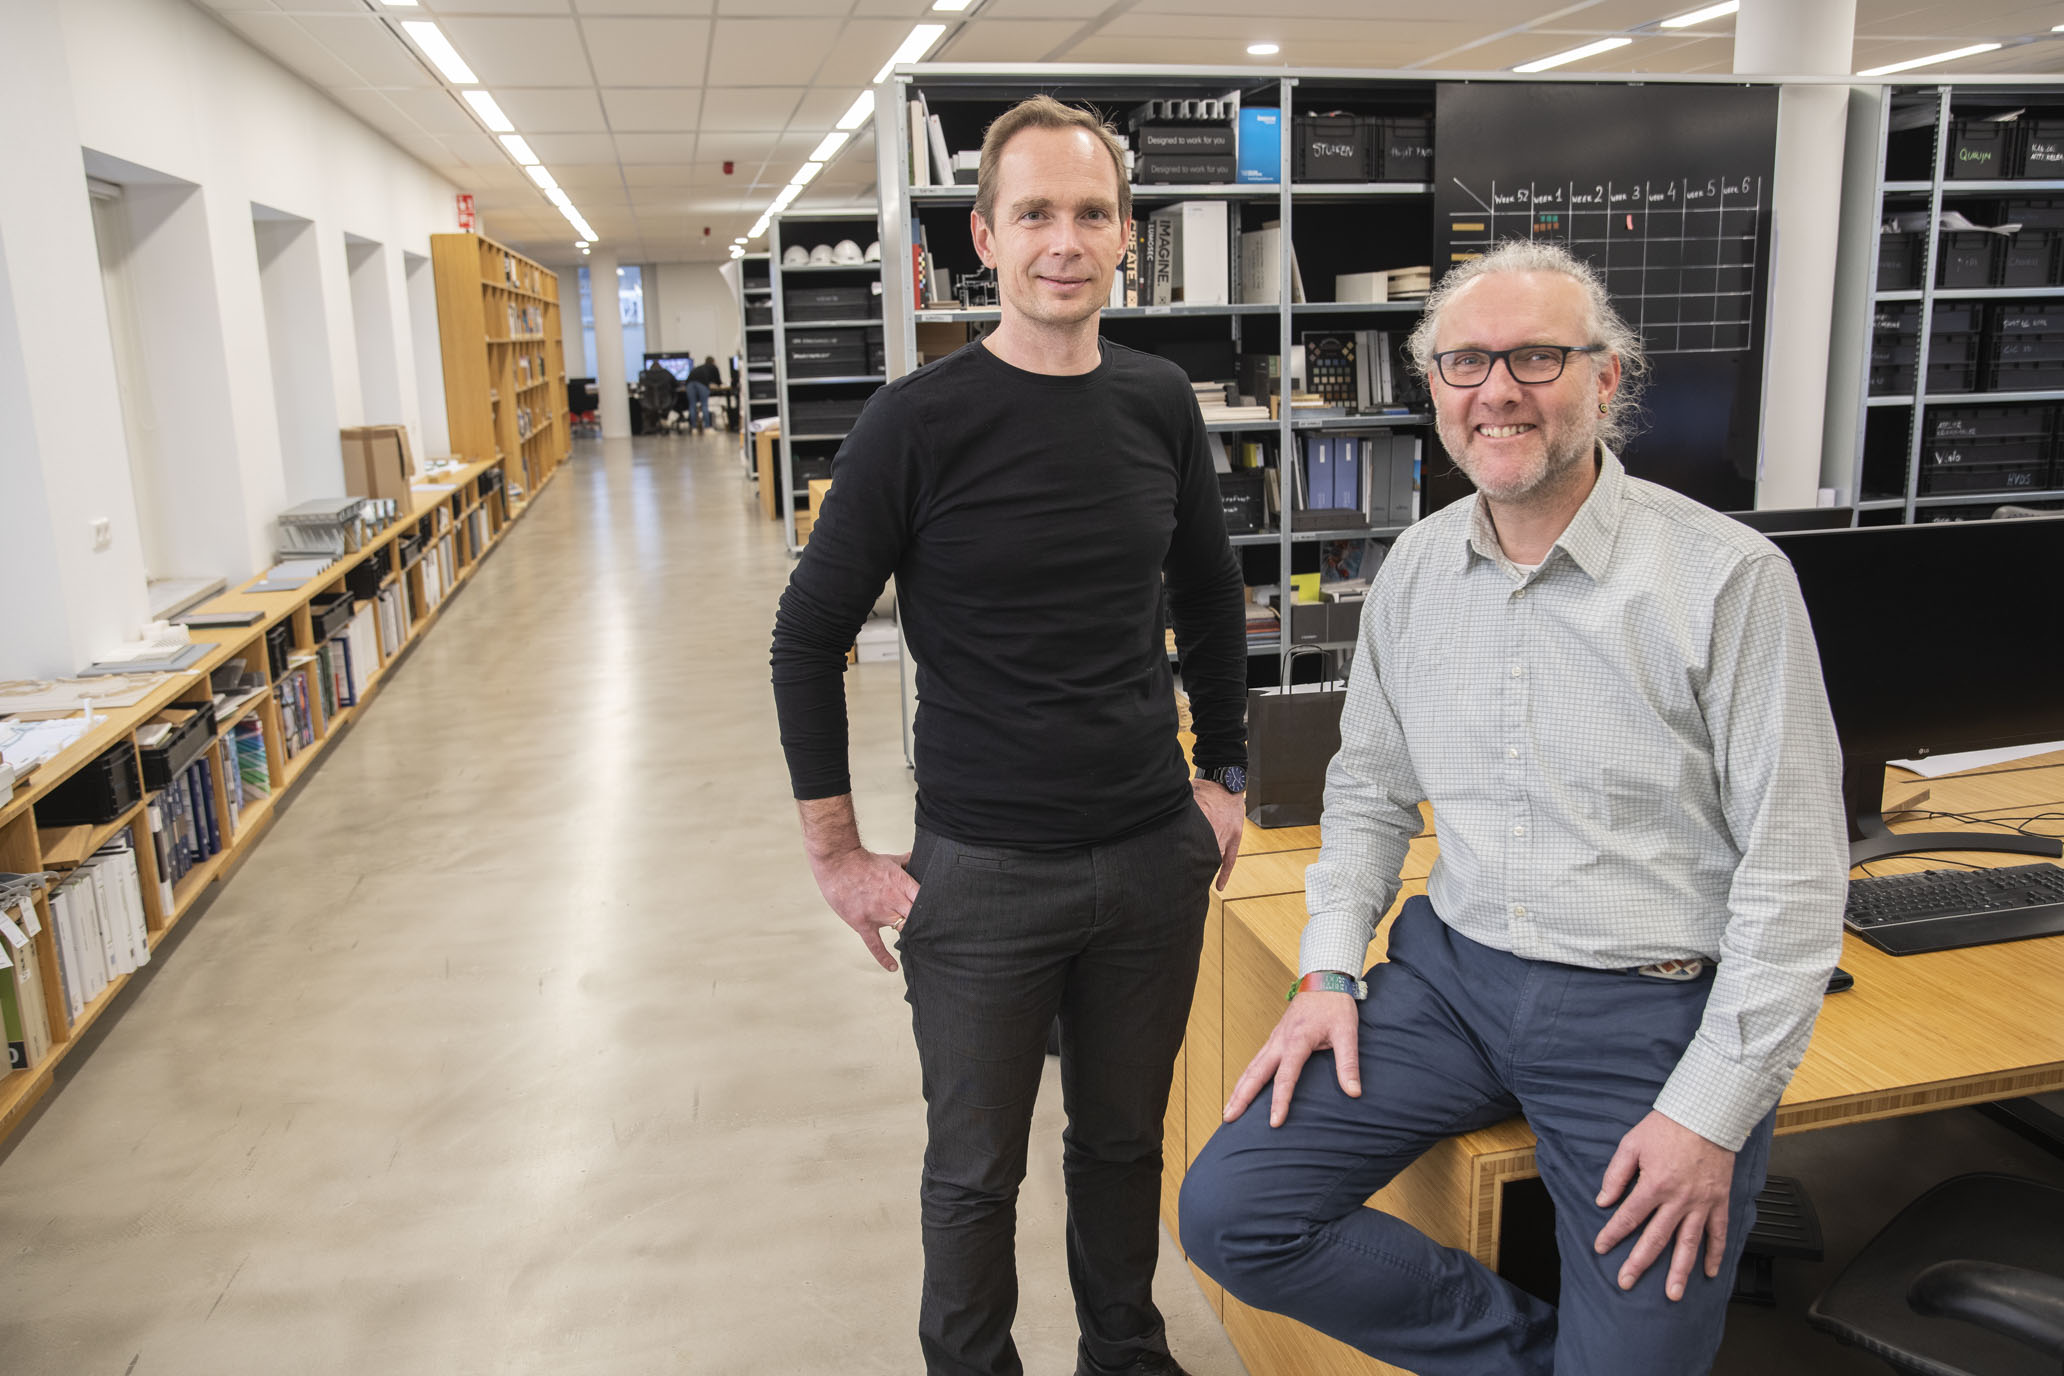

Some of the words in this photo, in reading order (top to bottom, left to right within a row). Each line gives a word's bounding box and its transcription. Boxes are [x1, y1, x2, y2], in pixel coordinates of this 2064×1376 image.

[1147, 135, 1178, 146] Designed
[1178, 136, 1186, 144] to
[1186, 136, 1202, 144] work
[1203, 135, 1212, 144] for
[1213, 137, 1226, 146] you
[1151, 165, 1181, 174] Designed
[1181, 165, 1189, 173] to
[1189, 165, 1205, 173] work
[1206, 165, 1215, 173] for
[1216, 166, 1229, 175] you
[1631, 185, 1640, 200] 3
[1667, 181, 1676, 202] 4
[1706, 179, 1716, 196] 5
[1741, 176, 1751, 193] 6
[1555, 187, 1563, 202] 1
[1594, 185, 1603, 203] 2
[1146, 223, 1155, 262] LUMOSEC
[1157, 219, 1171, 287] IMAGINE.
